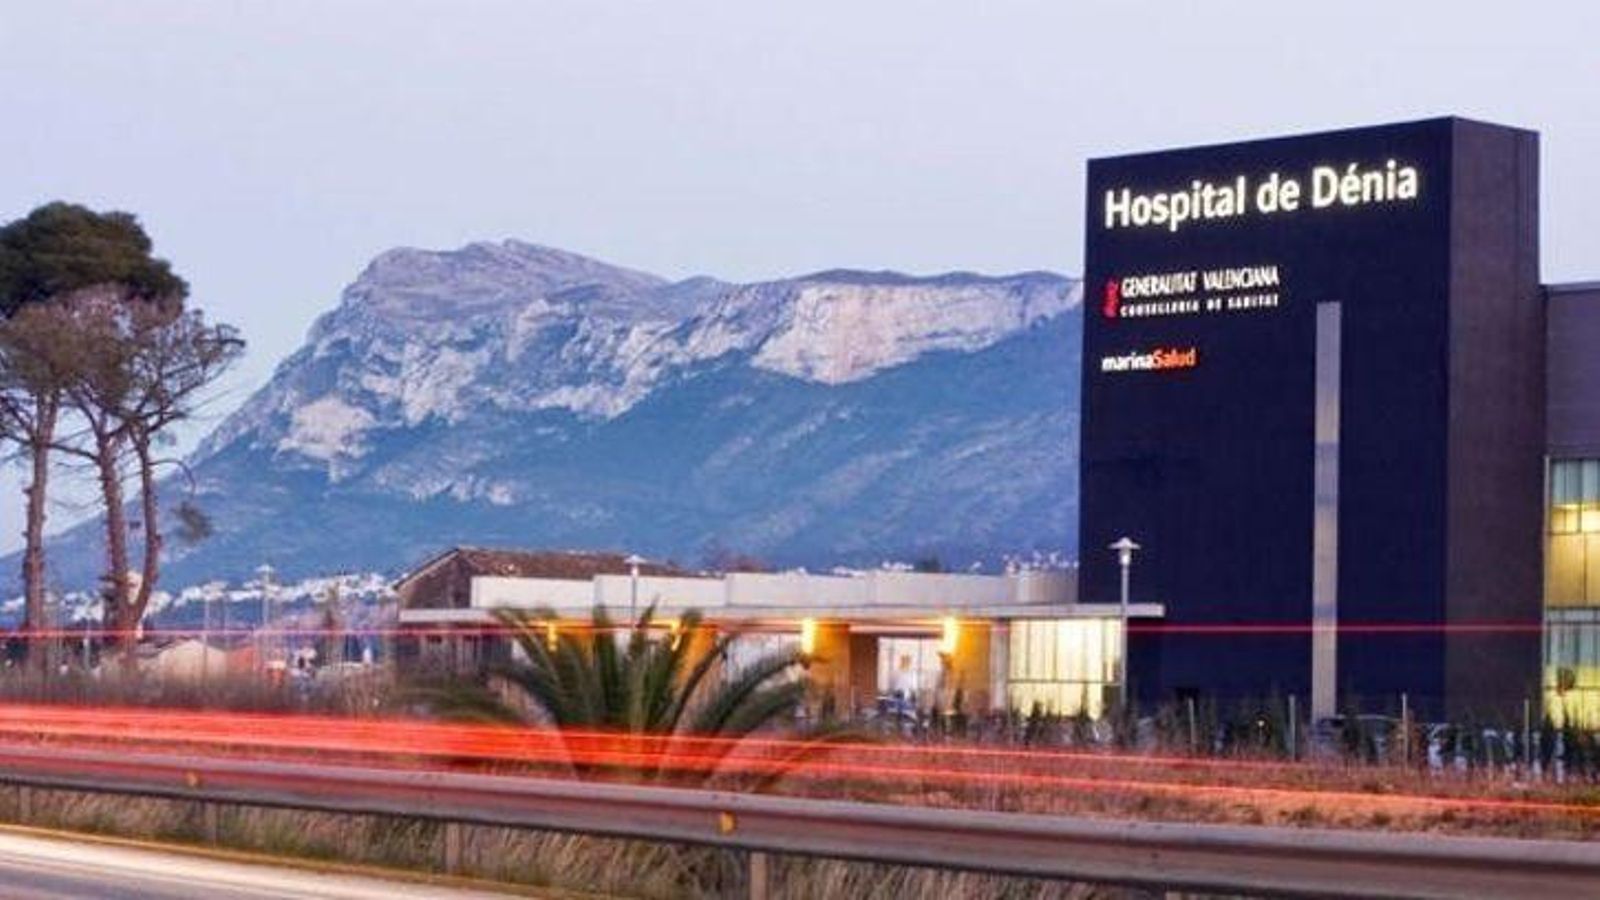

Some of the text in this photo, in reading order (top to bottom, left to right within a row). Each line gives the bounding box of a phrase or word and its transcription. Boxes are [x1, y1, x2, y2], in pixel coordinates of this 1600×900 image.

[1105, 159, 1417, 232] Hospital de Dénia
[1121, 266, 1280, 298] GENERALITAT VALENCIANA
